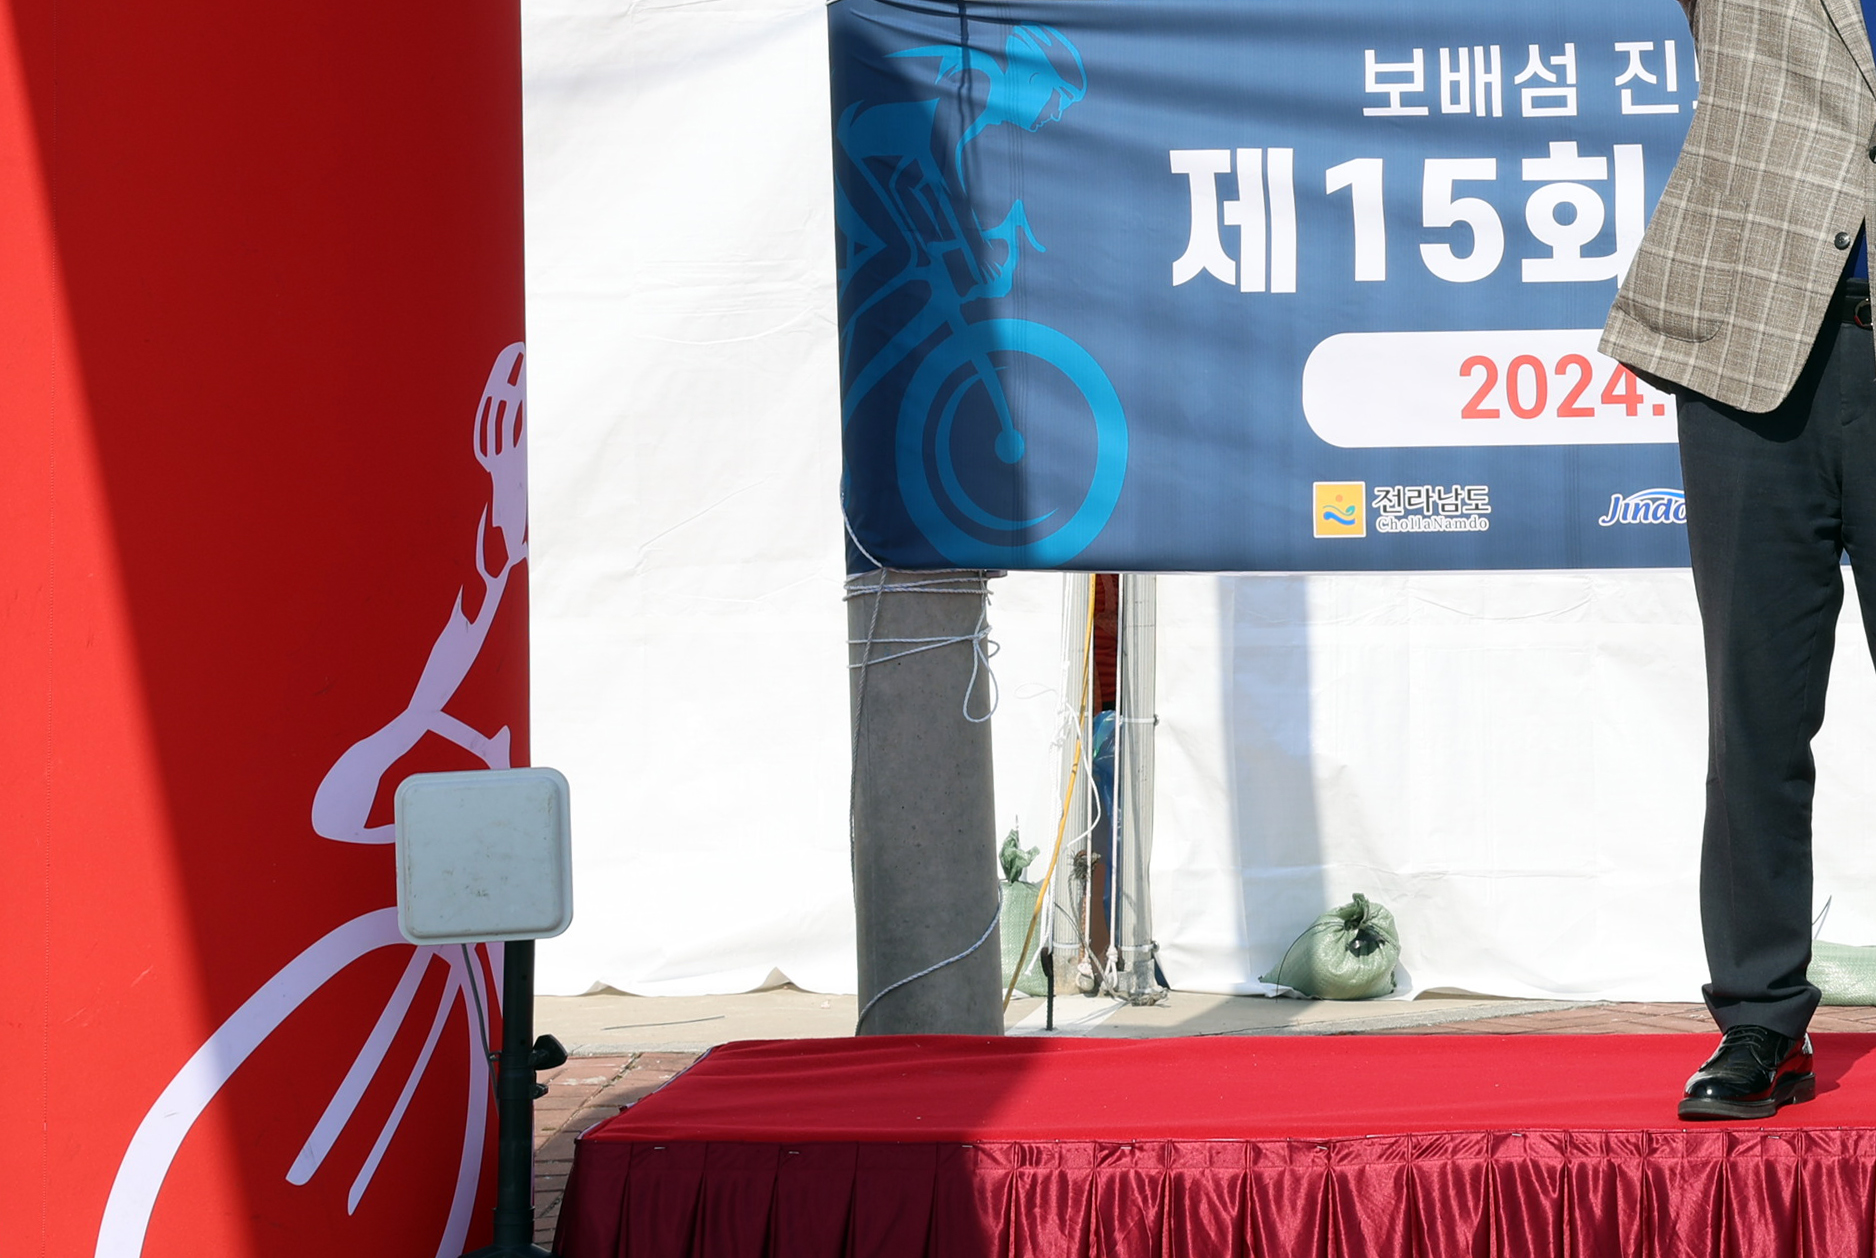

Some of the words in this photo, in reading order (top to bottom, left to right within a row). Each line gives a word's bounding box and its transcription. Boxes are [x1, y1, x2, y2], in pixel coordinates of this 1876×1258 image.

[1362, 43, 1577, 117] 보배섬
[1614, 40, 1700, 115] 진
[1169, 141, 1645, 294] 제15회
[1459, 353, 1665, 420] 2024.
[1373, 486, 1490, 515] 전라남도
[1600, 494, 1687, 525] Jindo
